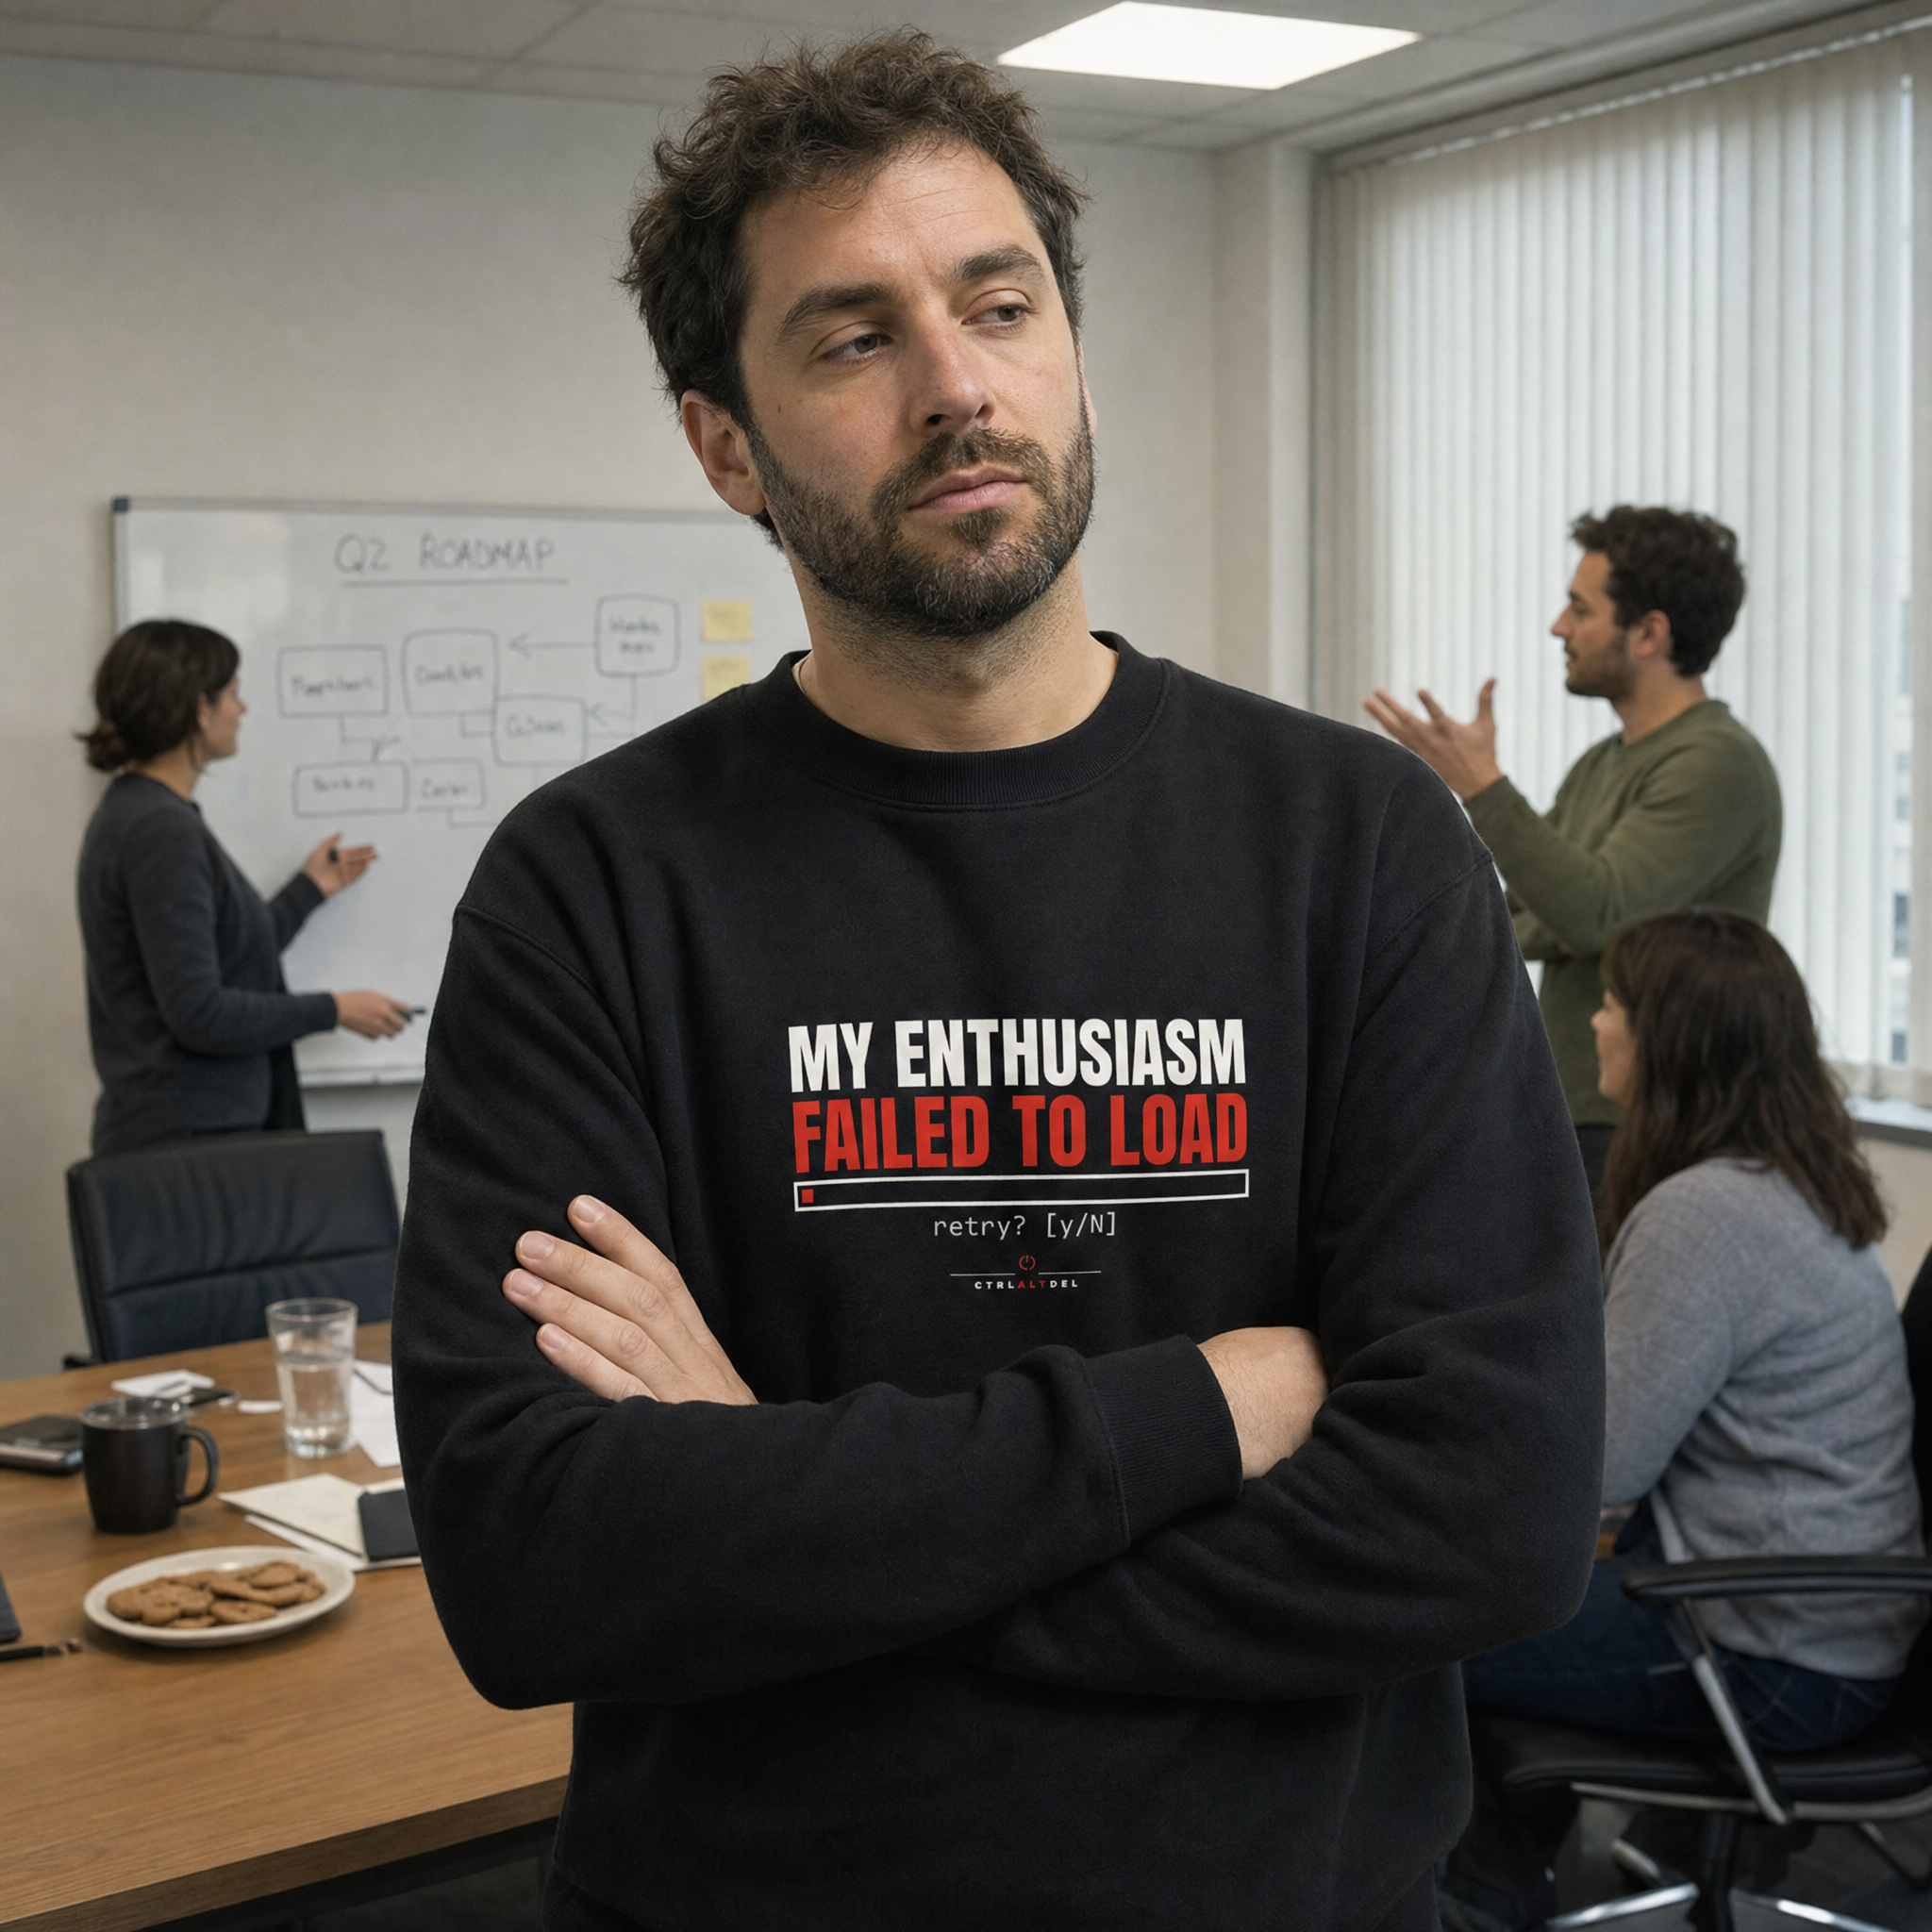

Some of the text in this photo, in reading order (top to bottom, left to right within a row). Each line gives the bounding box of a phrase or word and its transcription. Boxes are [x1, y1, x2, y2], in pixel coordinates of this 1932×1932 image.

[334, 532, 556, 574] Q2 ROADMAP
[788, 1018, 1246, 1092] MY ENTHUSIASM
[791, 1092, 1248, 1174] FAILED TO LOAD
[934, 1211, 1116, 1241] retry? [y/N]
[974, 1279, 1078, 1290] CTRLALTDEL
